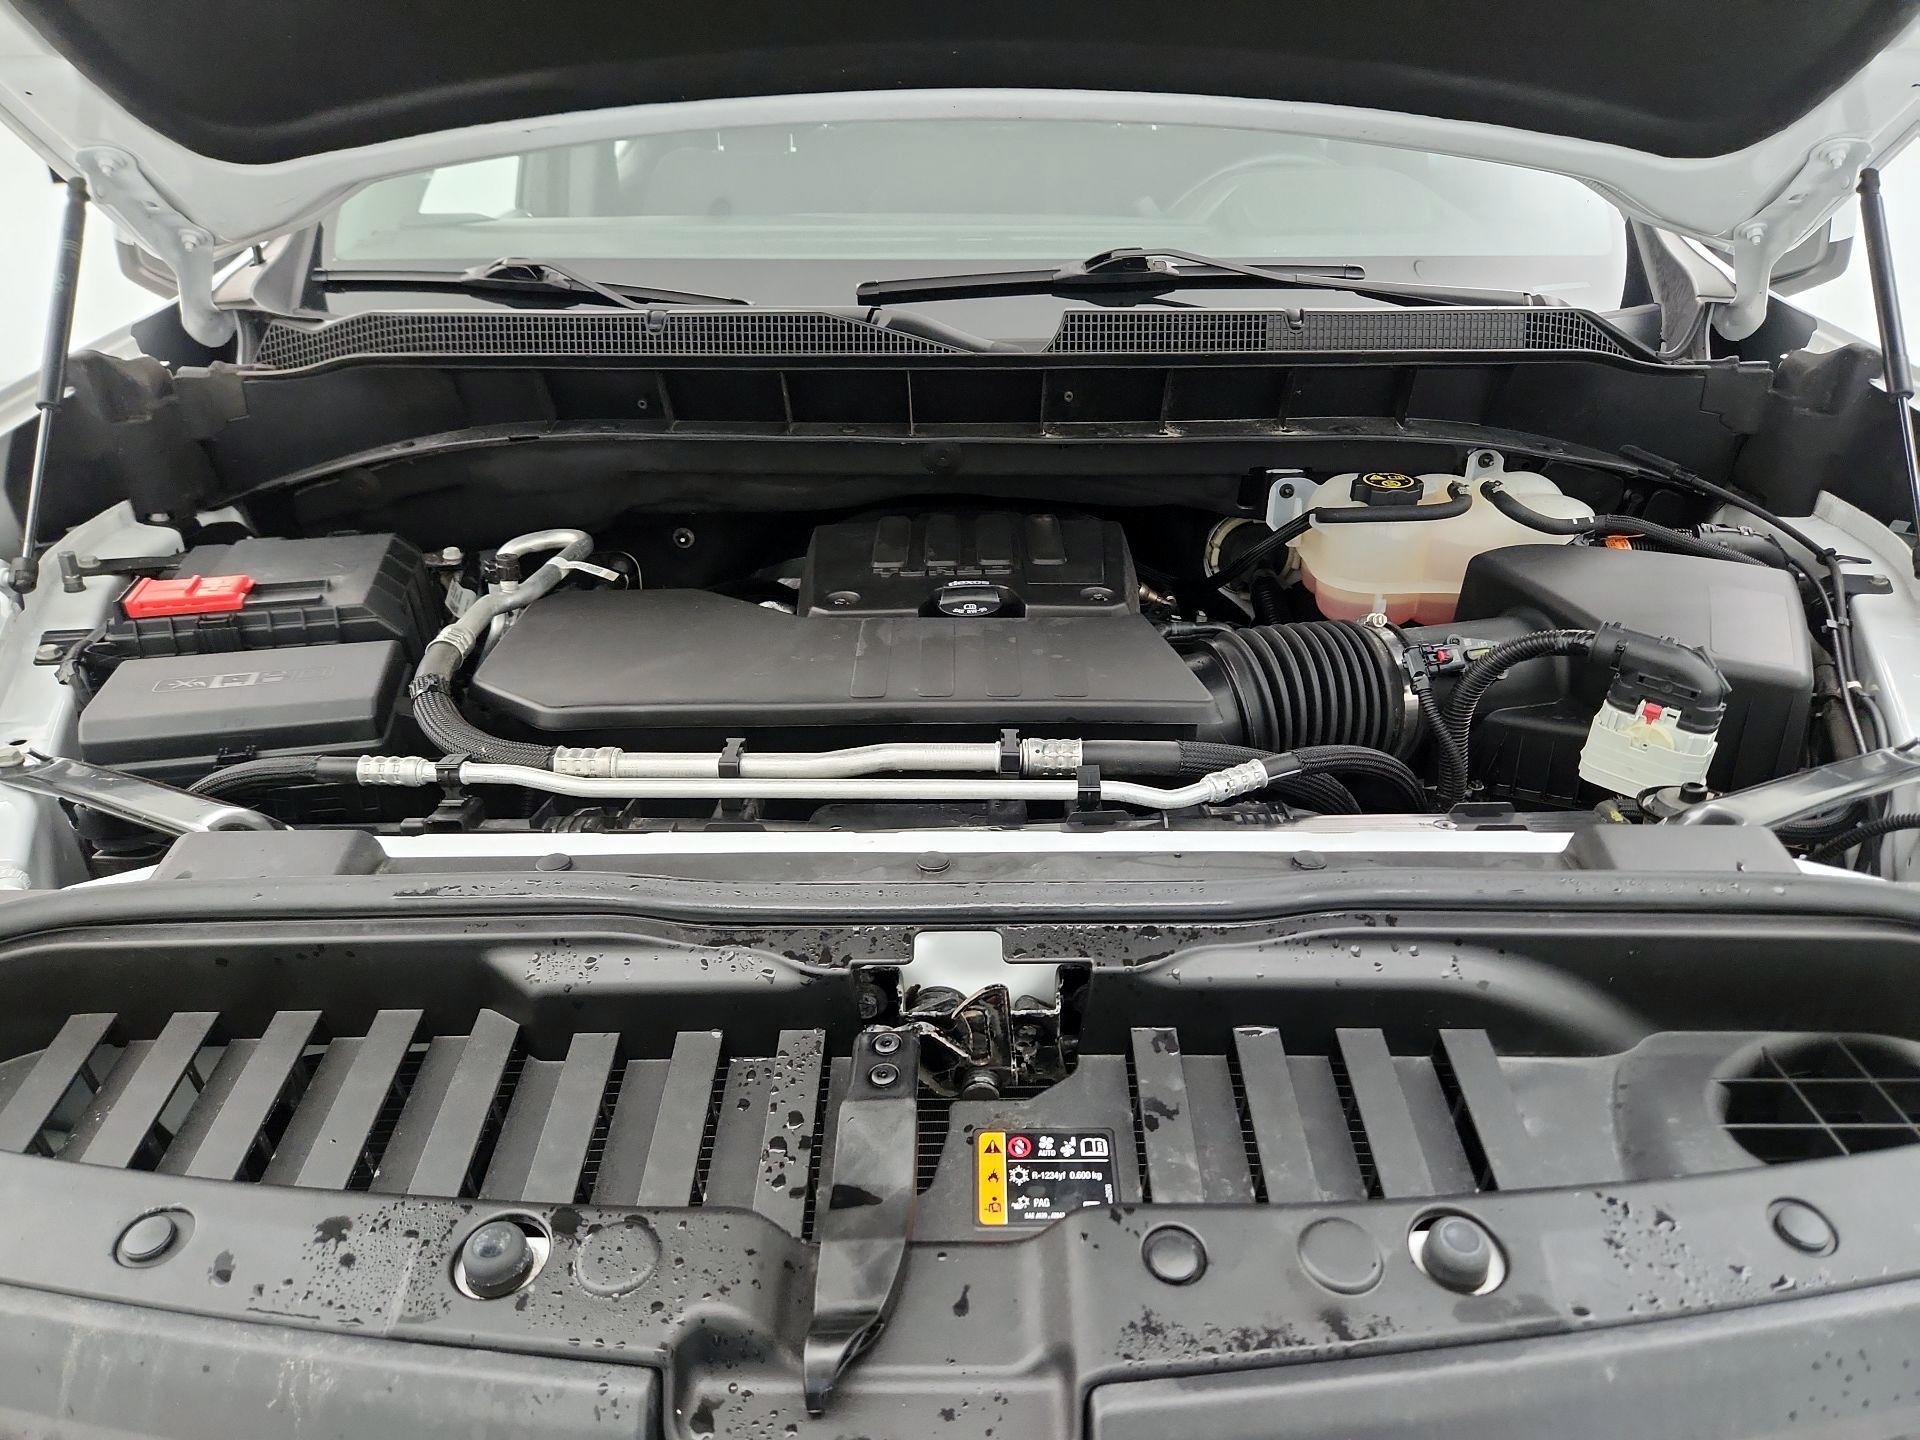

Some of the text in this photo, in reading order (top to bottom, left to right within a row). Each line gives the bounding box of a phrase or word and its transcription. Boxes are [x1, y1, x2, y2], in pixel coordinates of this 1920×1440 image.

[1038, 1149, 1056, 1157] AUTO
[1031, 1171, 1103, 1182] R-1234yf 0.600 kg
[1033, 1198, 1050, 1208] PAG
